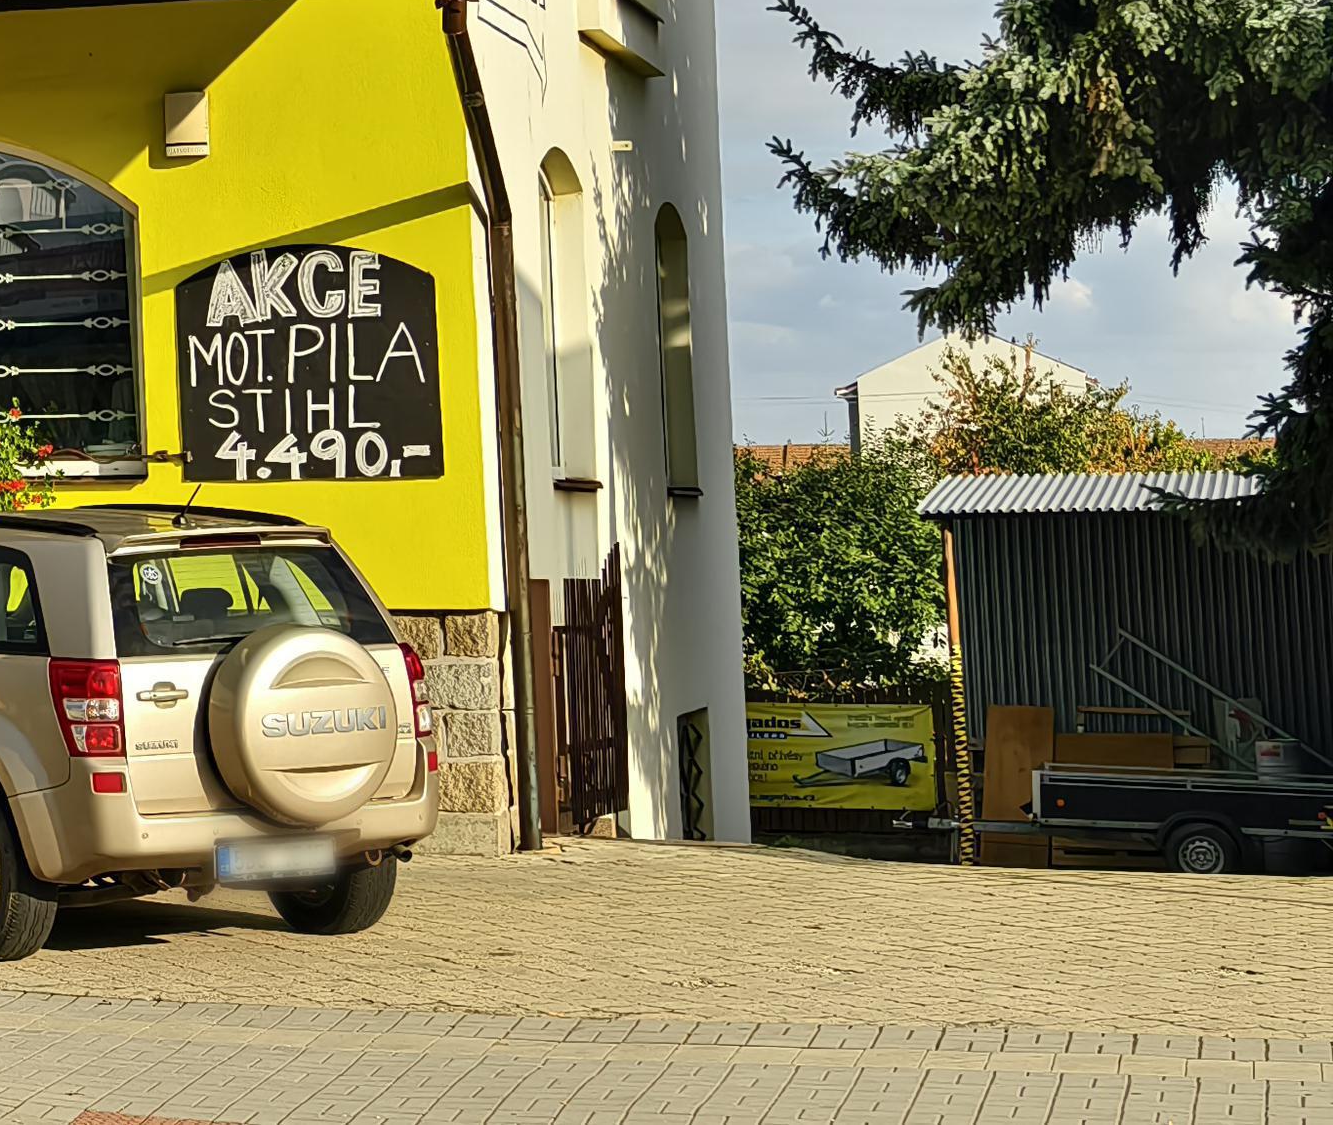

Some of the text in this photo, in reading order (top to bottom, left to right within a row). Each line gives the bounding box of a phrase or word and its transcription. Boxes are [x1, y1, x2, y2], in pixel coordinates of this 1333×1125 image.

[205, 248, 382, 327] AKCE
[187, 321, 426, 387] MOT. PILA
[207, 384, 381, 434] STIHL
[134, 739, 179, 751] SUZUKI
[262, 705, 387, 738] SUZUKI
